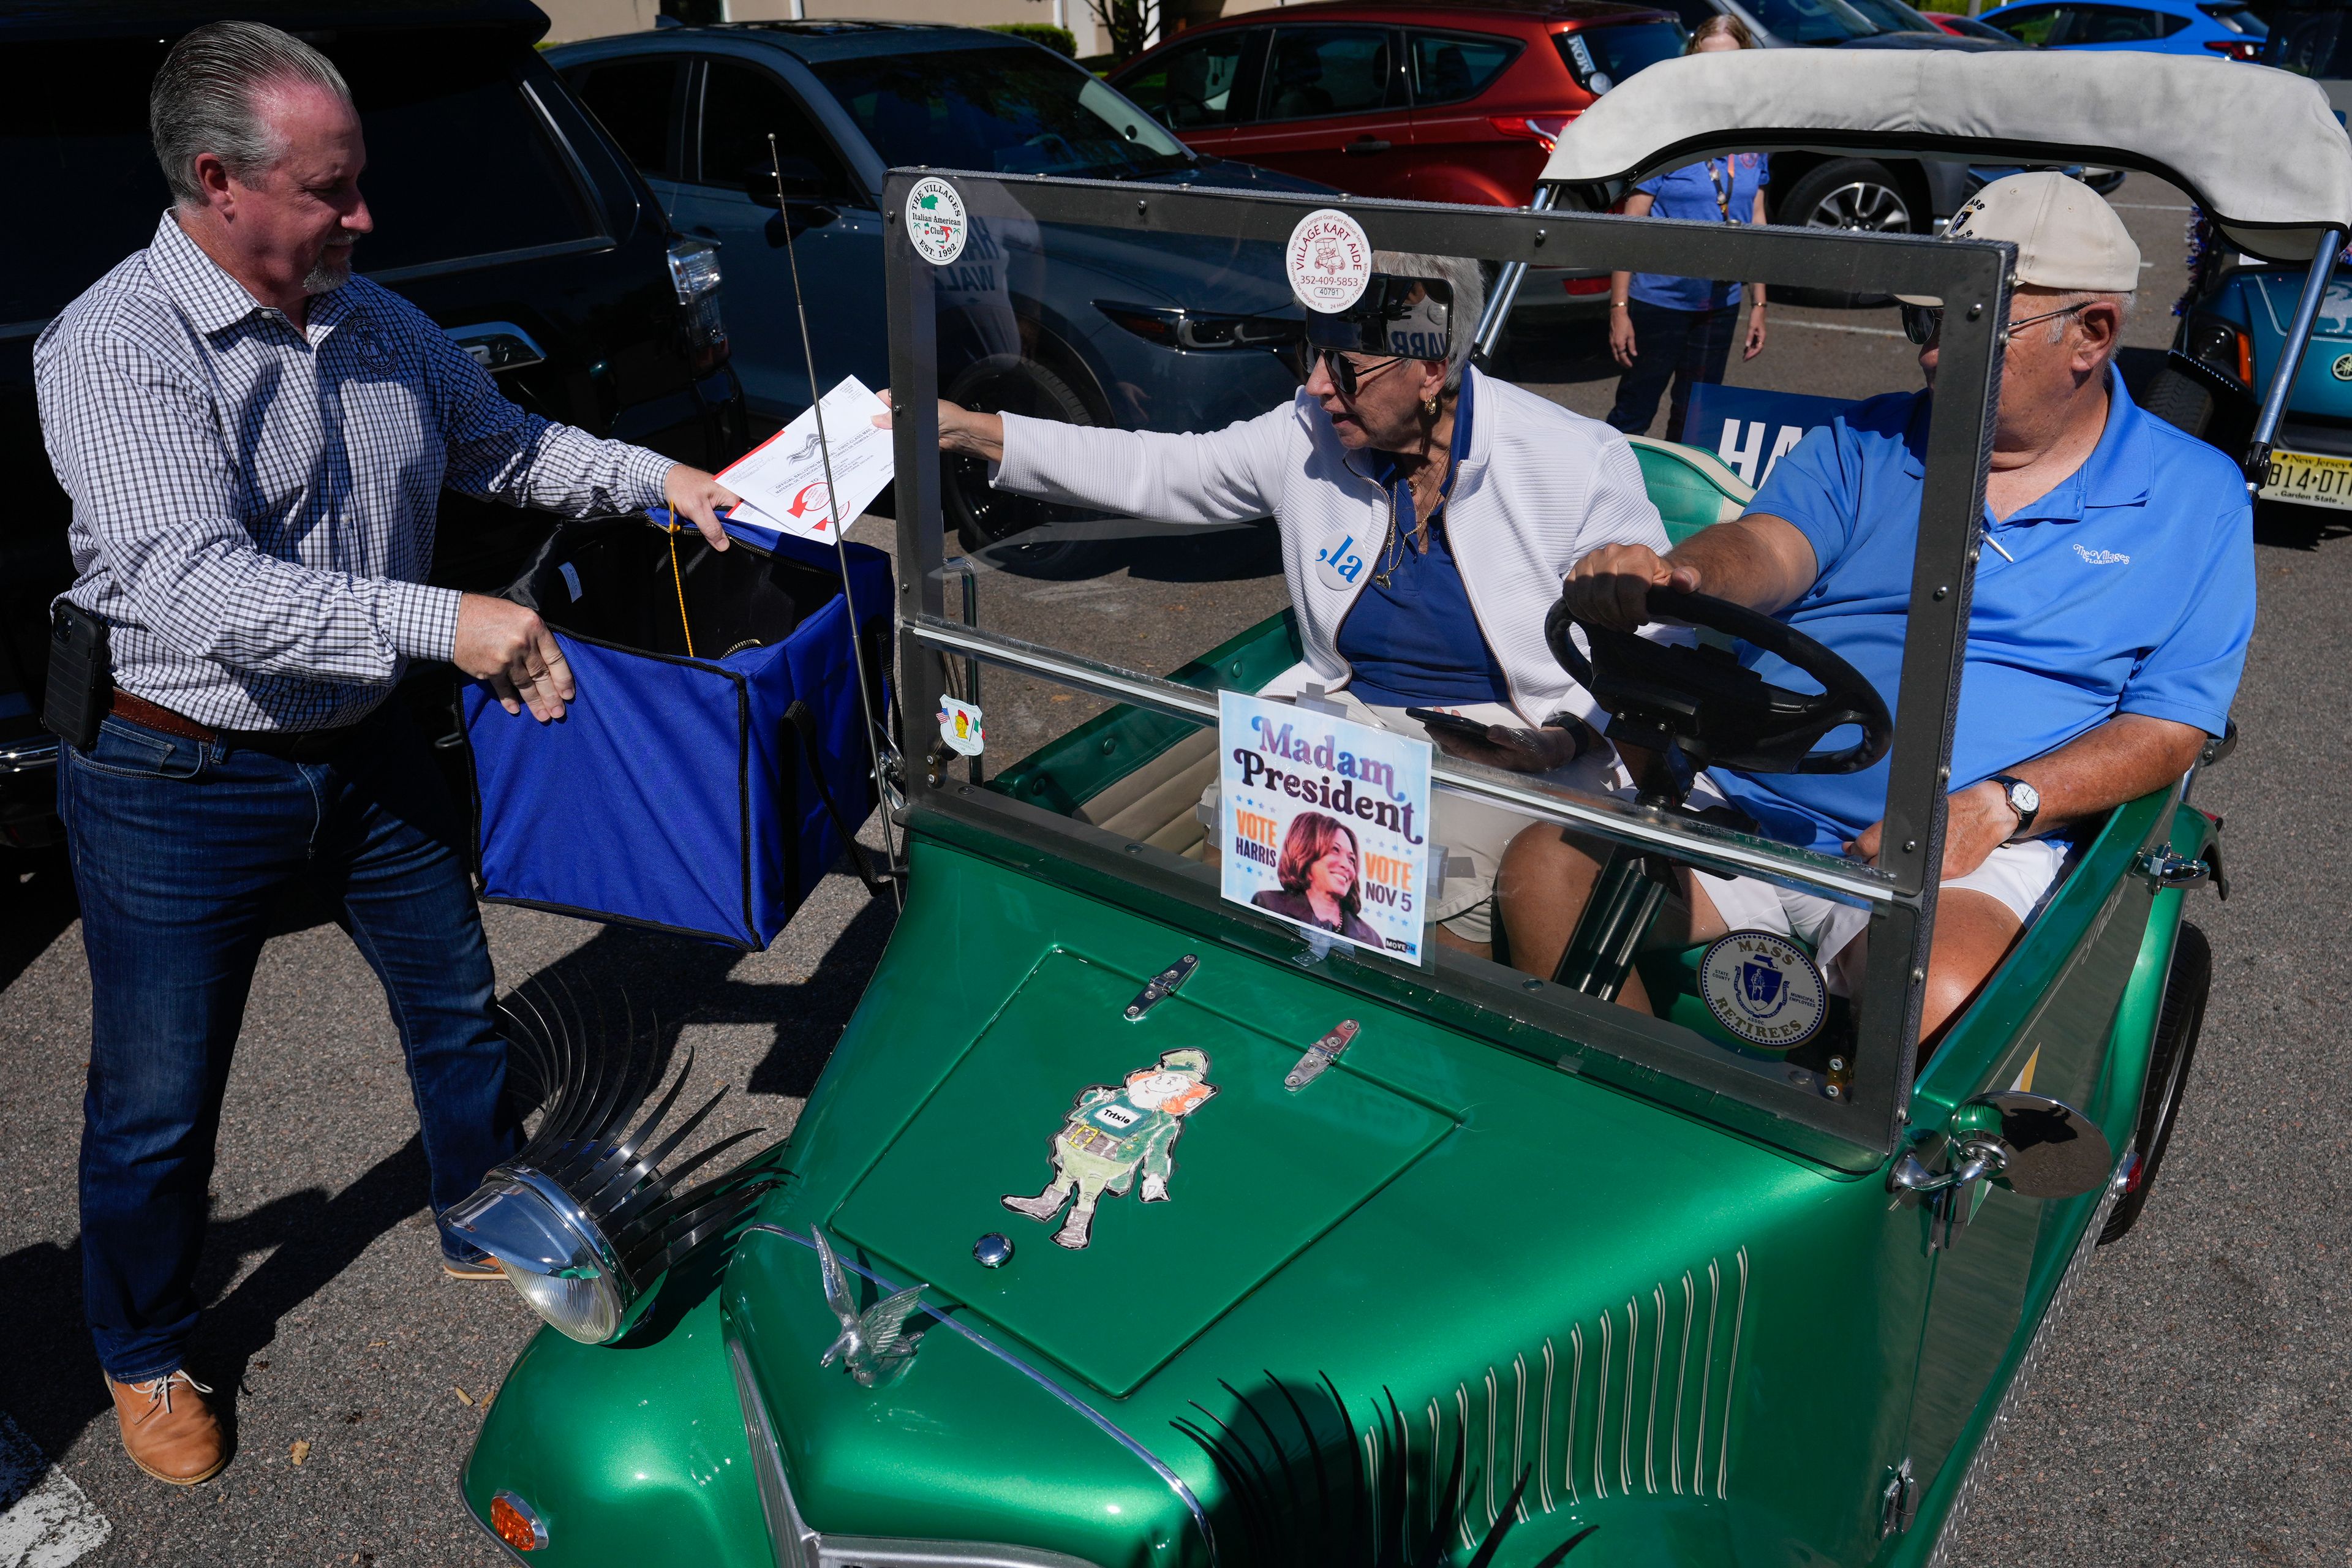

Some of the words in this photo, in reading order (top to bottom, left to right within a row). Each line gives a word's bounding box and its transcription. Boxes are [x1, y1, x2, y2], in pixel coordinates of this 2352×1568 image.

[911, 190, 924, 211] THE
[924, 184, 961, 217] VILLAGES
[912, 213, 932, 222] Italian
[933, 215, 961, 226] American
[930, 227, 944, 235] Club
[1295, 224, 1308, 240] World's
[1307, 215, 1323, 226] Largest
[1343, 221, 1357, 235] Rescue
[1356, 234, 1365, 253] Service
[1295, 225, 1321, 271] VILLAGE
[1324, 222, 1351, 241] KART
[1347, 243, 1362, 271] AIDE
[919, 239, 935, 257] EST.
[938, 243, 957, 258] 1992
[1300, 275, 1358, 287] 352-409-5853
[1336, 300, 1350, 309] Hours
[1355, 283, 1364, 296] Days
[2290, 454, 2314, 465] New
[2314, 457, 2348, 469] Jersey
[775, 476, 794, 489] OFFICIAL
[793, 462, 817, 478] BALLOTING
[2280, 490, 2311, 500] Garden
[2314, 495, 2337, 503] State
[2073, 543, 2090, 559] The
[2090, 549, 2130, 565] Villages
[1251, 714, 1407, 802] Madam
[1232, 747, 1425, 845] President
[1235, 808, 1278, 849] VOTE
[1235, 836, 1277, 869] HARRIS
[1365, 850, 1413, 892] VOTE
[1365, 881, 1398, 907] NOV
[1400, 892, 1412, 913] 5
[1736, 940, 1795, 966] MASS
[1712, 973, 1731, 982] COUNTY
[1789, 997, 1816, 1008] EMPLOYEES
[1790, 992, 1816, 1003] MUNICIPAL
[1714, 997, 1802, 1039] RETIREES
[1747, 1016, 1766, 1027] ASSOC.
